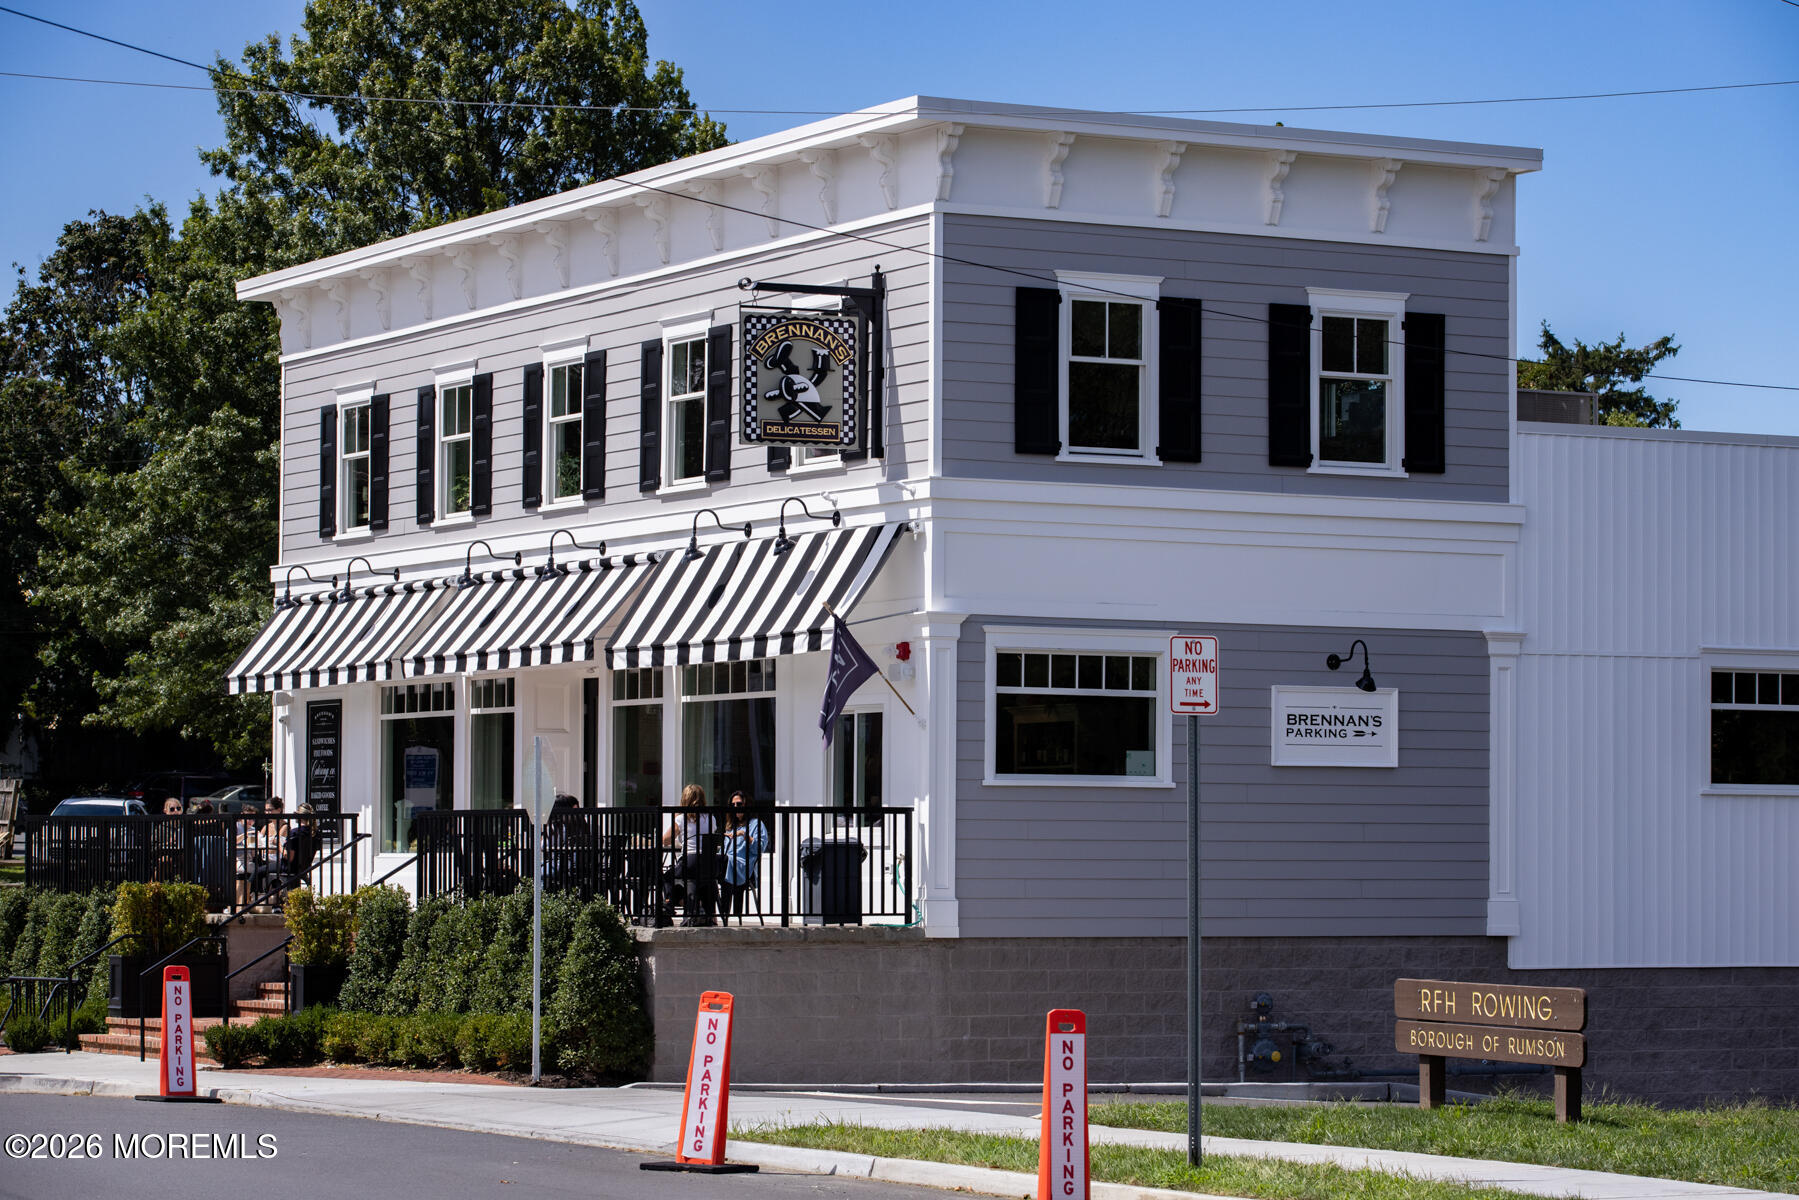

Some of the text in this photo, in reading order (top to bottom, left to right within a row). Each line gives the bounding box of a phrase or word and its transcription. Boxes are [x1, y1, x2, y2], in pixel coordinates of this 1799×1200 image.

[755, 324, 848, 361] BRENNAN'S
[766, 425, 836, 436] DELICATESSEN
[1184, 640, 1203, 656] NO
[1172, 658, 1216, 674] PARKING
[1186, 676, 1202, 686] ANY
[1184, 688, 1204, 698] TIME
[1286, 713, 1383, 728] BRENNAN'S
[1286, 727, 1348, 739] PARKING
[1421, 988, 1553, 1021] RFH ROWING
[174, 985, 185, 1087] NO PARKING
[1410, 1029, 1565, 1059] BOROUGH OF RUMSON
[693, 1017, 719, 1152] NO PARKING
[1062, 1040, 1075, 1196] NO PARKING
